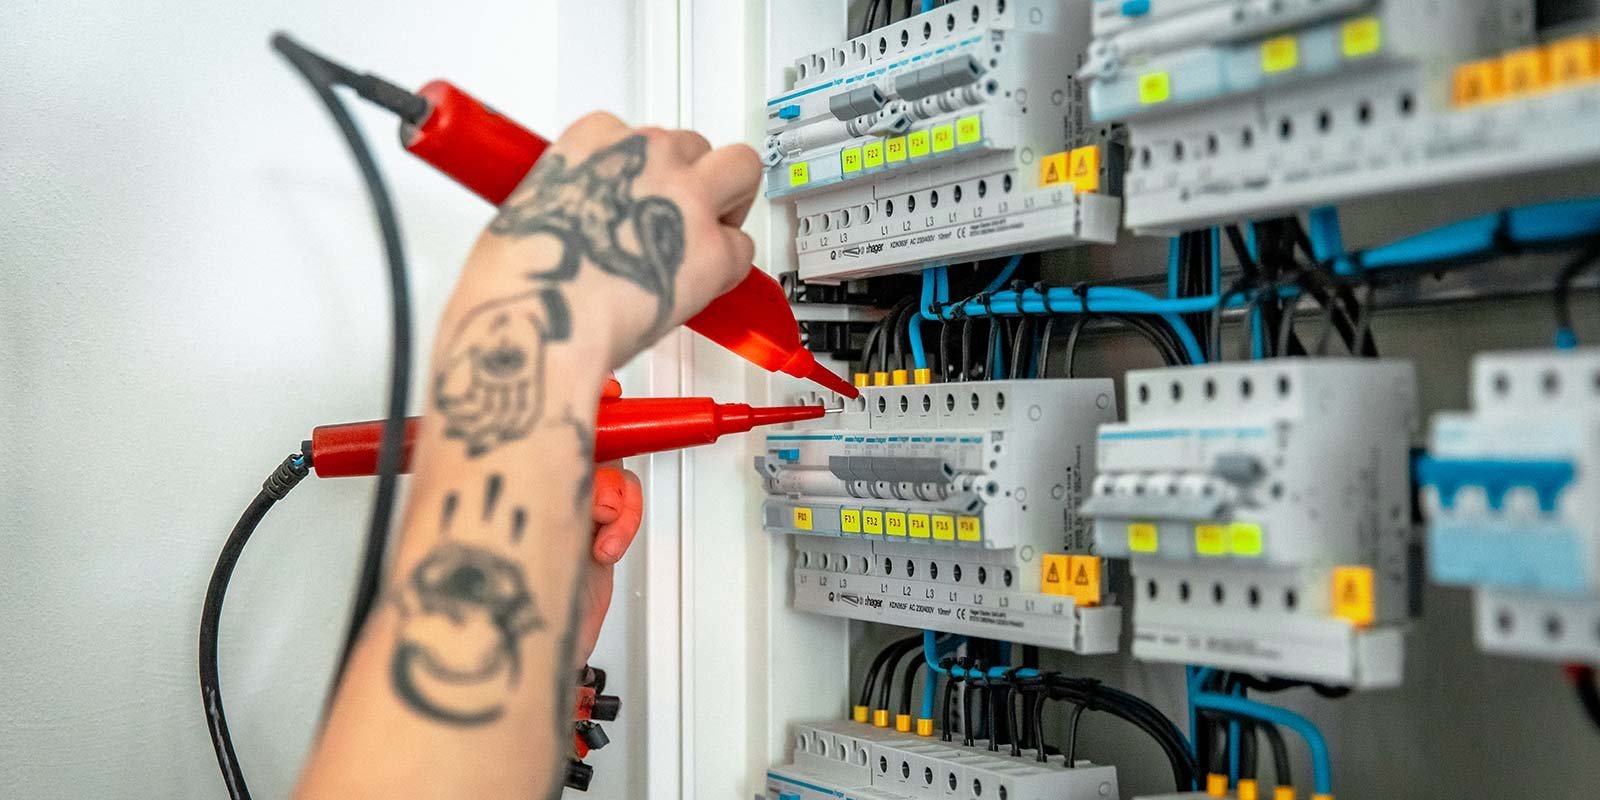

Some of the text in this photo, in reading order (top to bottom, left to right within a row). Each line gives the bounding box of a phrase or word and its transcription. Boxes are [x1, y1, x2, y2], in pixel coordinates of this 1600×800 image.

[881, 226, 889, 236] L1
[903, 220, 911, 231] L2
[925, 216, 935, 228] L3
[949, 212, 957, 223] L1
[973, 207, 983, 218] L2
[998, 202, 1008, 213] L3
[801, 233, 848, 250] L1 L2 L3
[820, 576, 827, 586] L2
[840, 579, 847, 588] L3
[881, 583, 888, 593] L1
[903, 586, 911, 596] L2
[925, 588, 935, 599] L3
[950, 591, 957, 602] L1
[974, 594, 983, 605] L2
[999, 597, 1009, 608] L3
